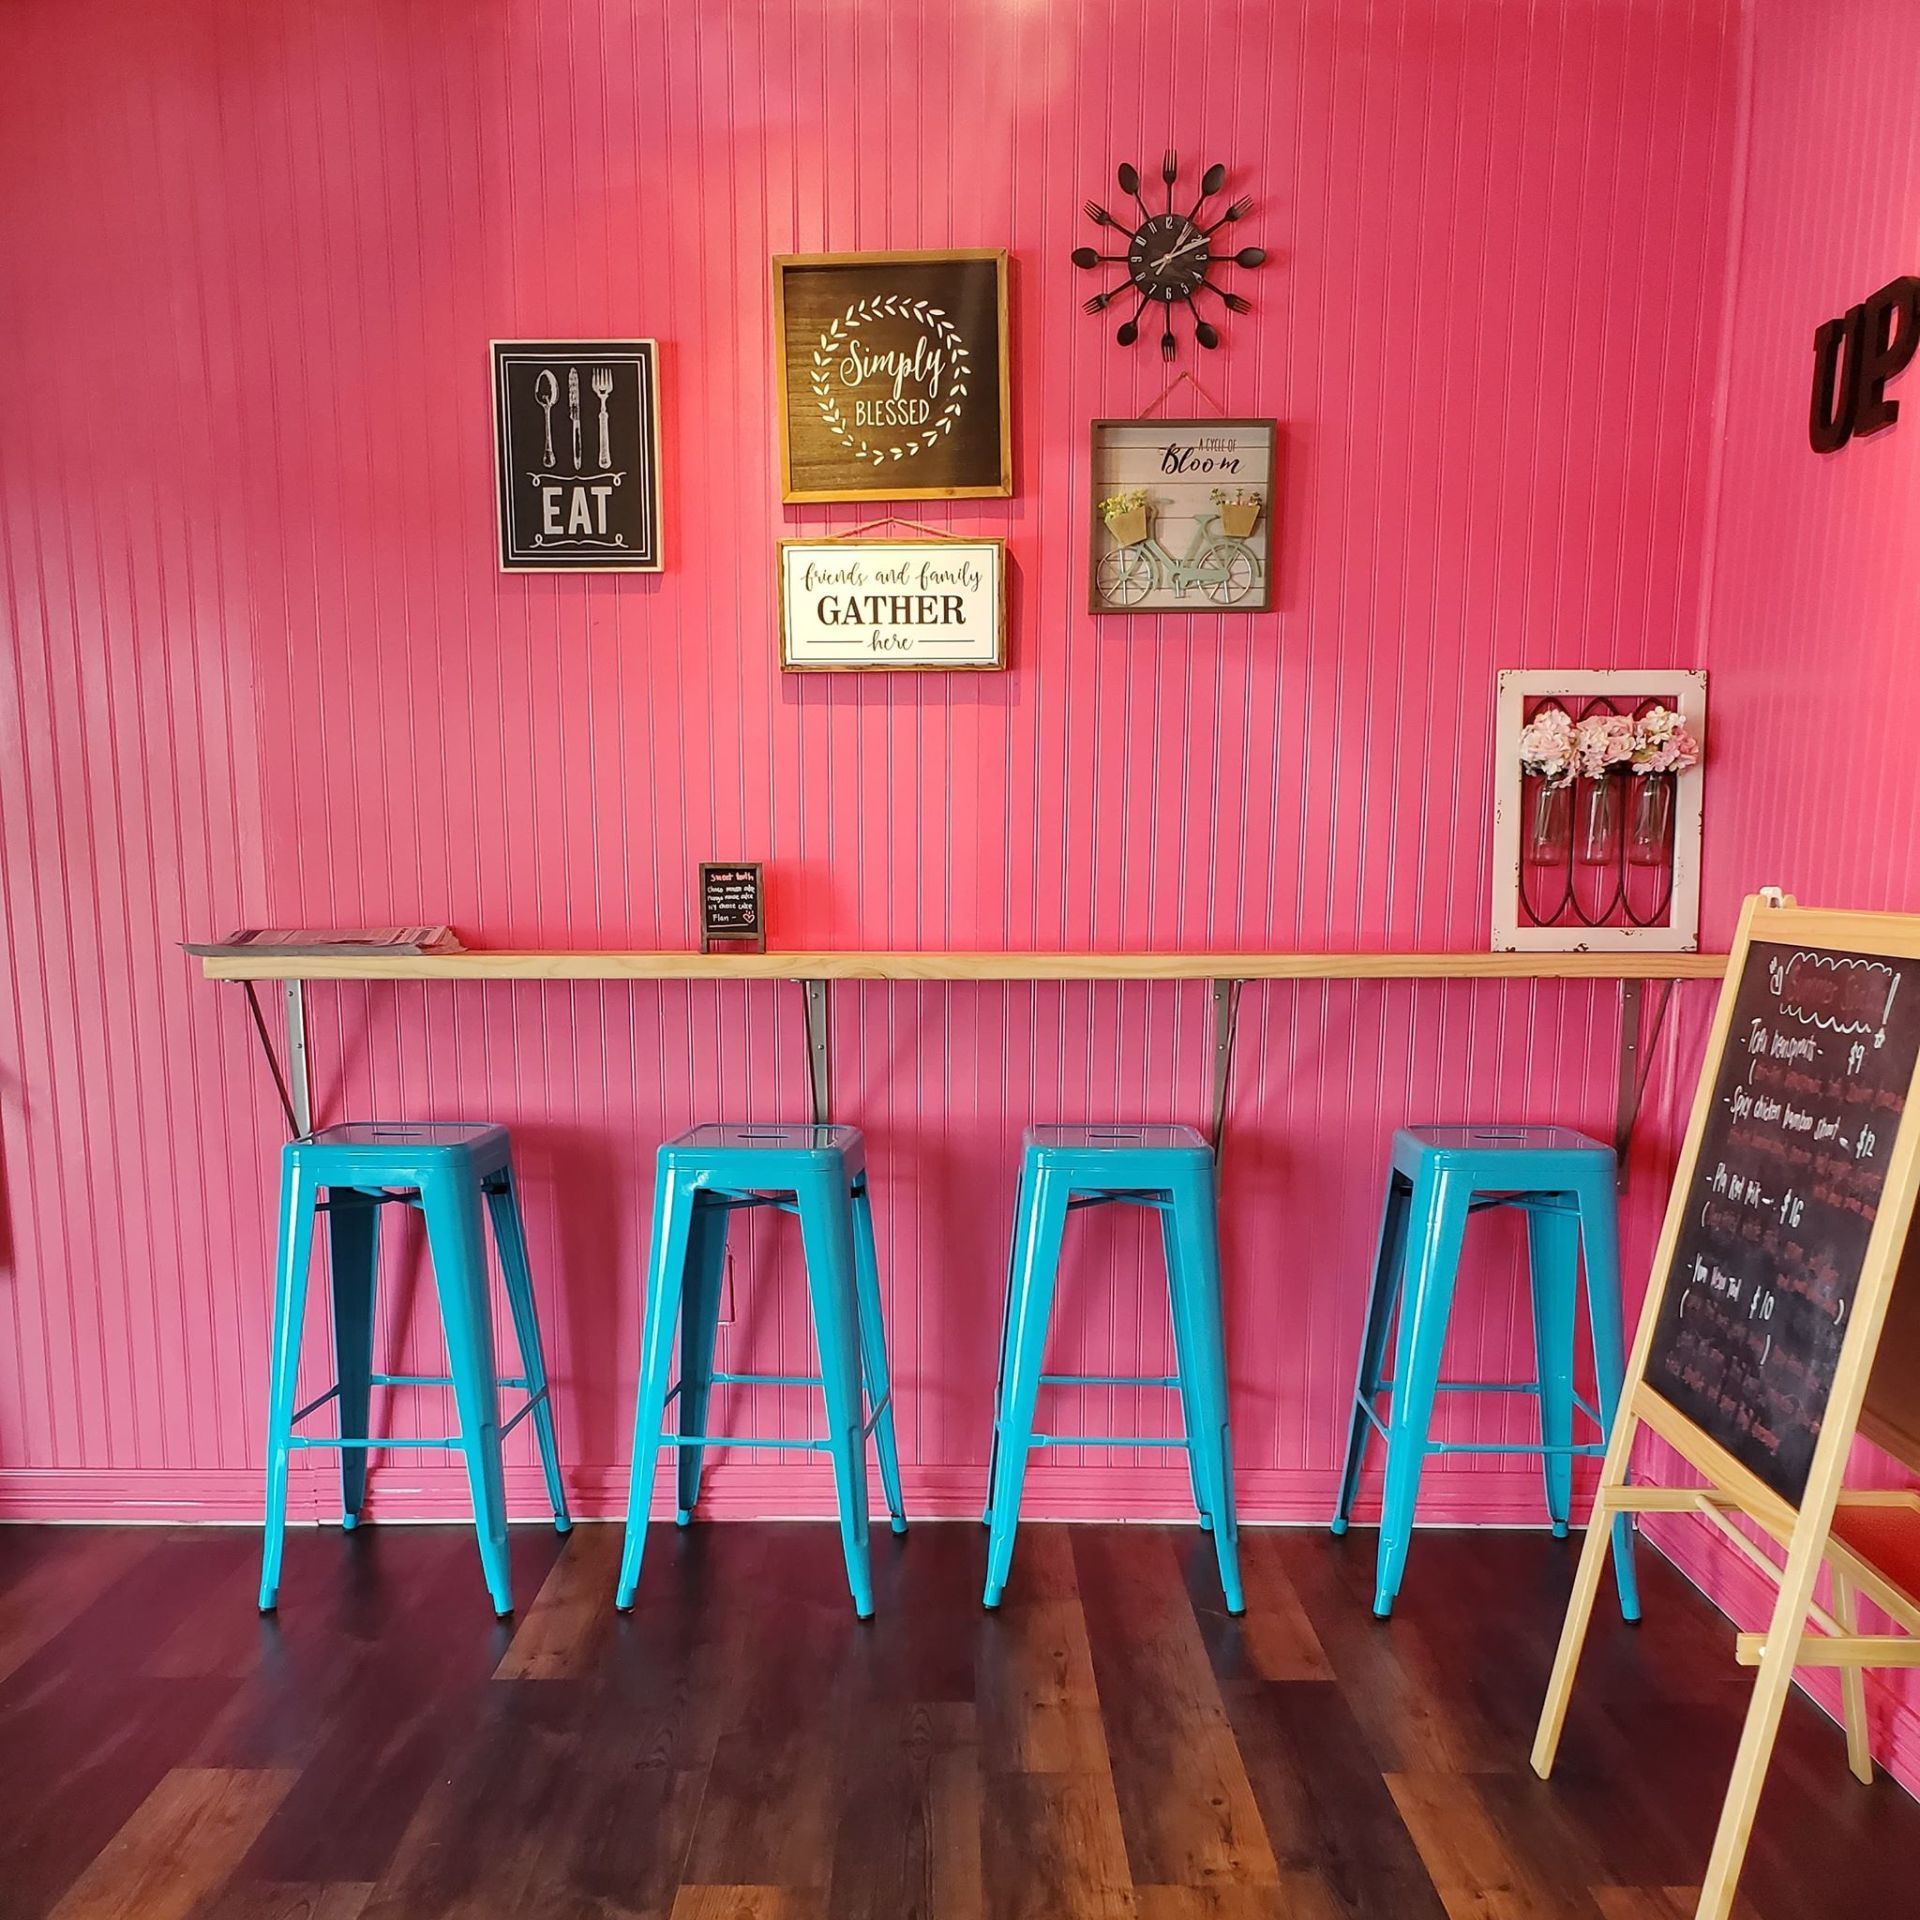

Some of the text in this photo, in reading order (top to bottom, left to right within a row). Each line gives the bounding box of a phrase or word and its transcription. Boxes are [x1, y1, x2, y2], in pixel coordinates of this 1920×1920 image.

[1148, 221, 1157, 234] 11
[1165, 216, 1173, 229] 12
[1148, 283, 1157, 295] 7
[1165, 287, 1172, 300] 6
[1180, 282, 1189, 295] 5
[840, 336, 946, 400] Simply
[1809, 276, 1920, 454] UP
[856, 399, 930, 426] BLESSED
[1159, 443, 1245, 475] Bloom
[1198, 438, 1238, 452] A CYCLE OF
[543, 487, 612, 534] EAT
[801, 561, 983, 592] friends and family
[817, 595, 967, 626] GATHER
[868, 630, 913, 651] here
[712, 913, 729, 922] Flan
[1847, 1041, 1865, 1075] $9
[1730, 1085, 1752, 1124] Spicy
[1855, 1124, 1875, 1159] $12
[1780, 1188, 1805, 1228] $16
[1748, 1285, 1775, 1321] $10
